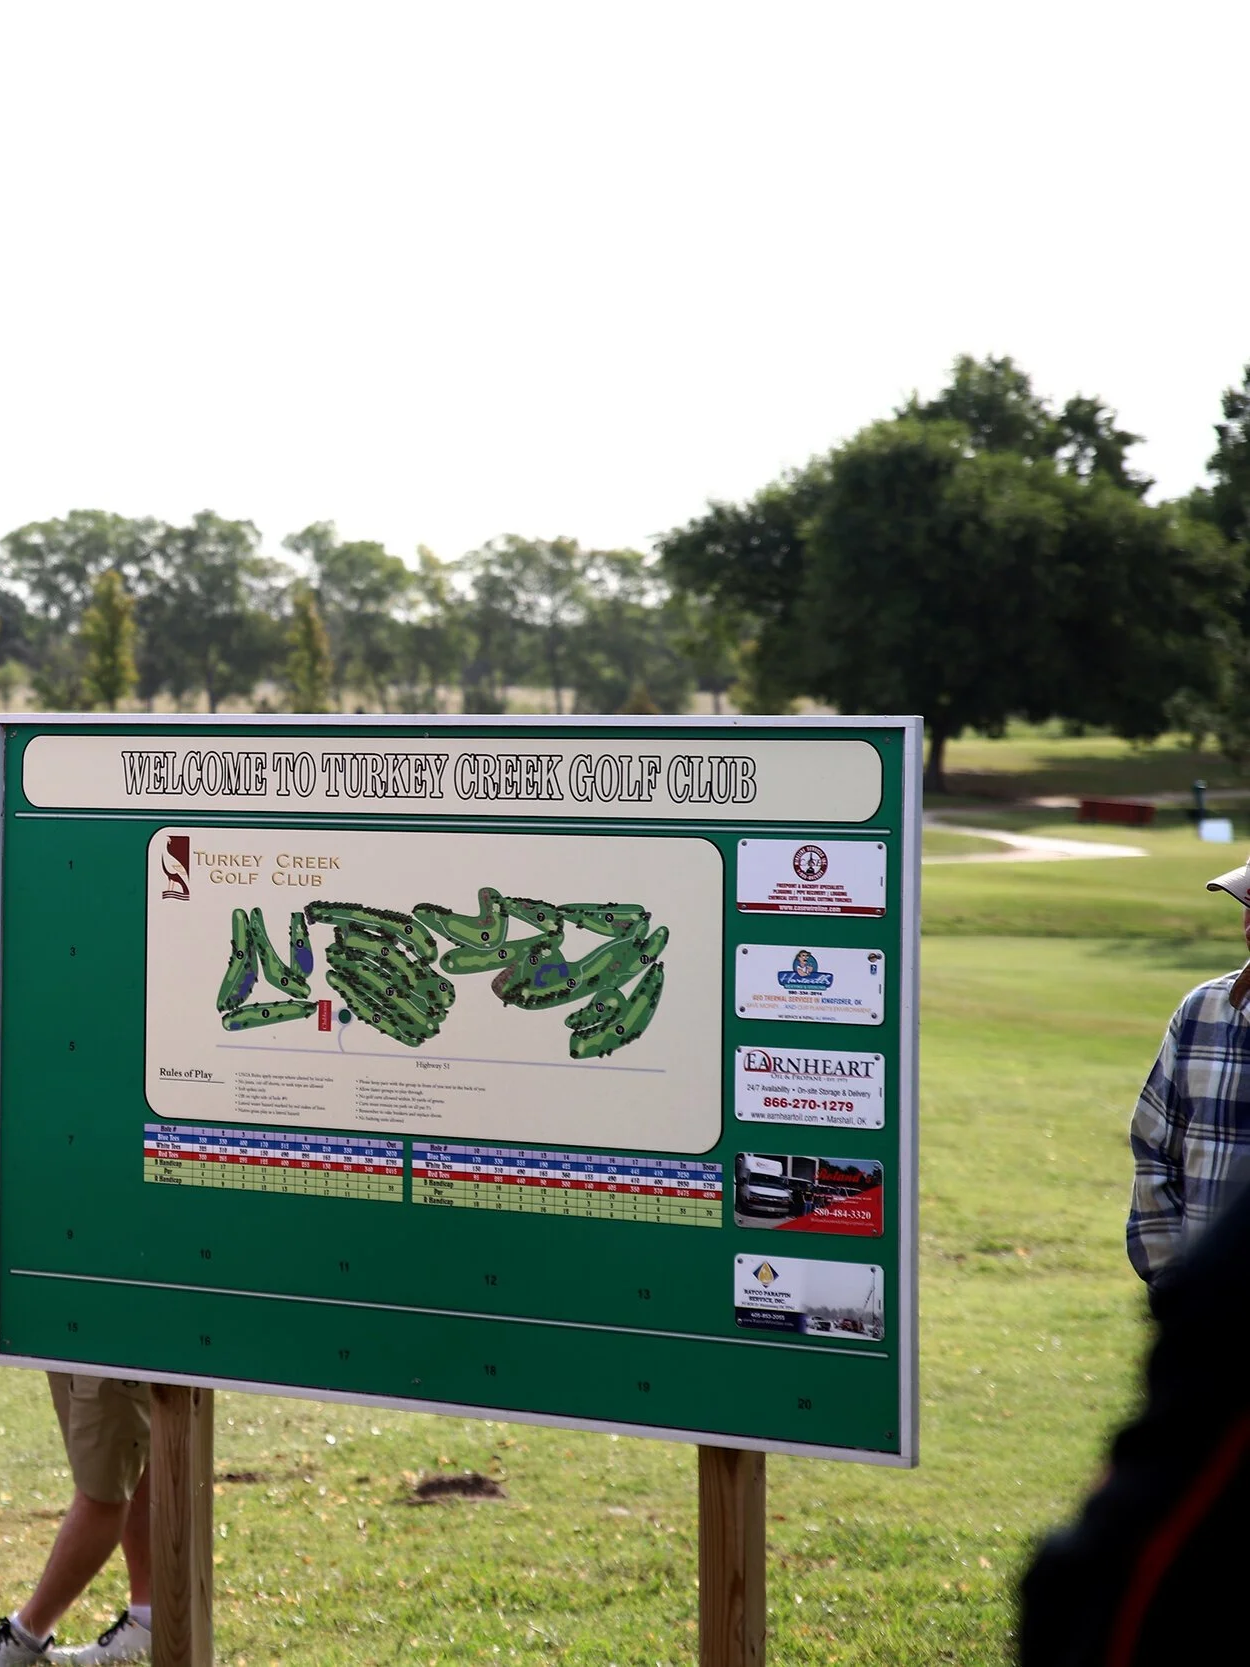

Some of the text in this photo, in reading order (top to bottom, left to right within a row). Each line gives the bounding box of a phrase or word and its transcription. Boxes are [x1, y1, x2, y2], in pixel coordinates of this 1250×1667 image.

[122, 752, 756, 804] WELCOME TO TURKEY CREEK GOLF CLUB
[69, 860, 73, 870] 1
[193, 851, 340, 869] TURKEY CREEK
[209, 870, 322, 887] GOLF CLUB
[70, 946, 76, 956] 3
[69, 1041, 75, 1051] 5
[416, 1061, 441, 1070] Highway
[747, 1053, 874, 1078] EARNHEART
[160, 1068, 213, 1081] Rules of Play
[762, 1085, 790, 1094] Availability
[819, 1088, 841, 1097] Storage
[848, 1090, 870, 1098] Delivery
[763, 1097, 853, 1112] 866-270-1279
[68, 1135, 74, 1145] 7
[159, 1159, 182, 1168] Handicap
[159, 1176, 182, 1185] Handicap
[429, 1180, 454, 1189] Handicap
[429, 1197, 454, 1206] Handicap
[814, 1207, 871, 1220] 580-484-3320
[67, 1230, 73, 1240] 9
[200, 1249, 211, 1259] 10
[339, 1261, 349, 1272] 11
[485, 1275, 497, 1286] 12
[638, 1289, 650, 1300] 13
[68, 1322, 78, 1332] 15
[200, 1336, 211, 1346] 16
[338, 1350, 350, 1360] 17
[484, 1365, 496, 1376] 18
[638, 1382, 650, 1392] 19
[798, 1398, 812, 1410] 20
